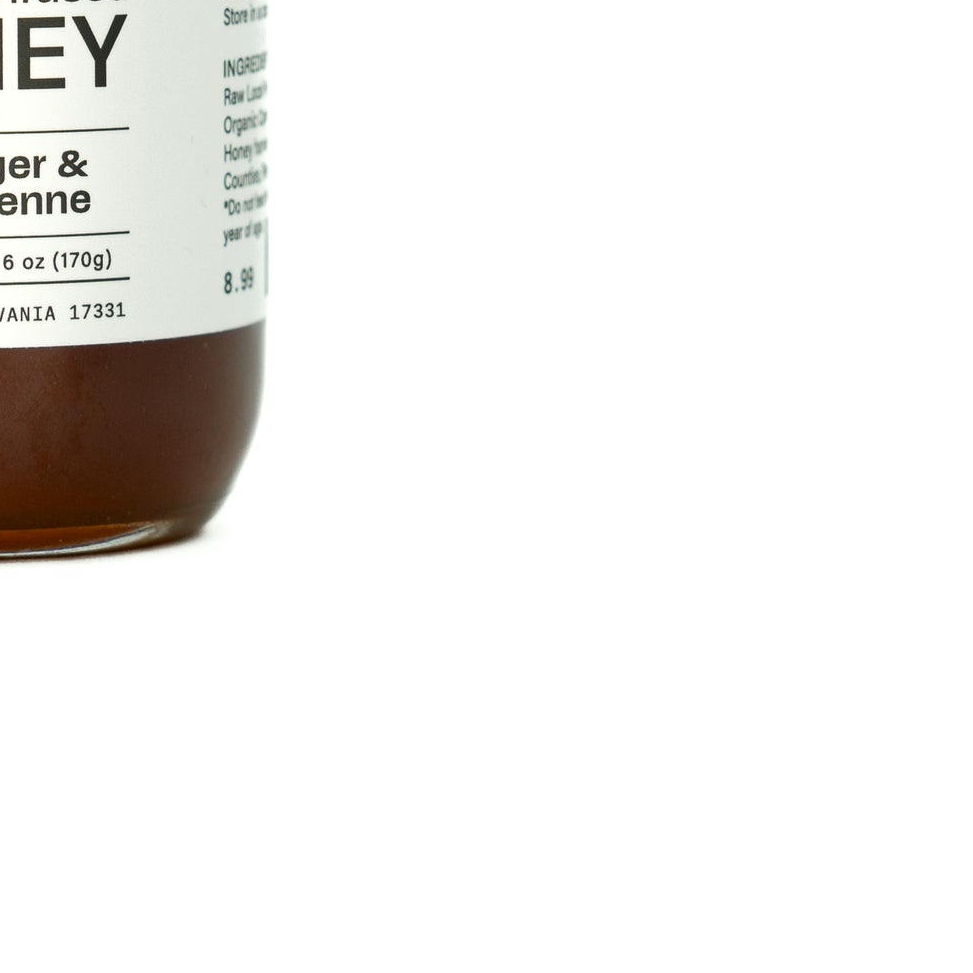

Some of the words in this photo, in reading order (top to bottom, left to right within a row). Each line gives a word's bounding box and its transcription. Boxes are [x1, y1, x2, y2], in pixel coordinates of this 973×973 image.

[223, 7, 248, 26] Store
[223, 87, 244, 106] Raw
[223, 143, 252, 163] Honey
[57, 149, 89, 178] &
[223, 227, 243, 247] year
[3, 254, 14, 271] 6
[22, 256, 45, 270] oz
[52, 248, 112, 273] (170g)
[224, 266, 254, 294] 8.99
[69, 301, 126, 320] 17331
